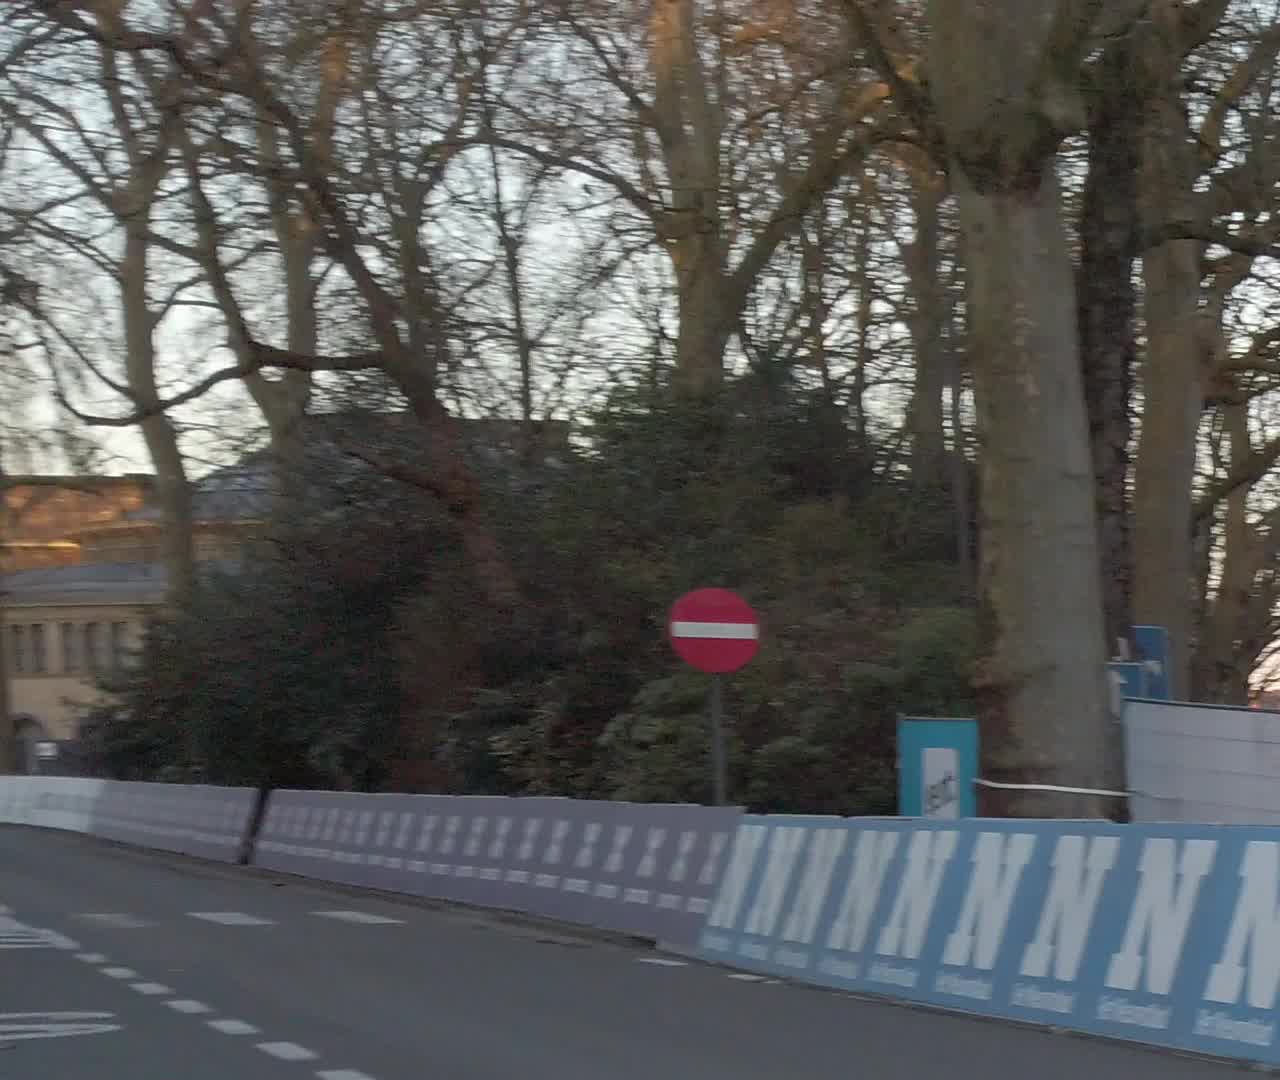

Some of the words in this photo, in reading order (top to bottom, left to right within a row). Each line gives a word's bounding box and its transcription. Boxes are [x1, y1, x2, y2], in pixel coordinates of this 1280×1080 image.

[940, 832, 1037, 970] N
[1019, 835, 1121, 982] N
[1103, 838, 1218, 995] N
